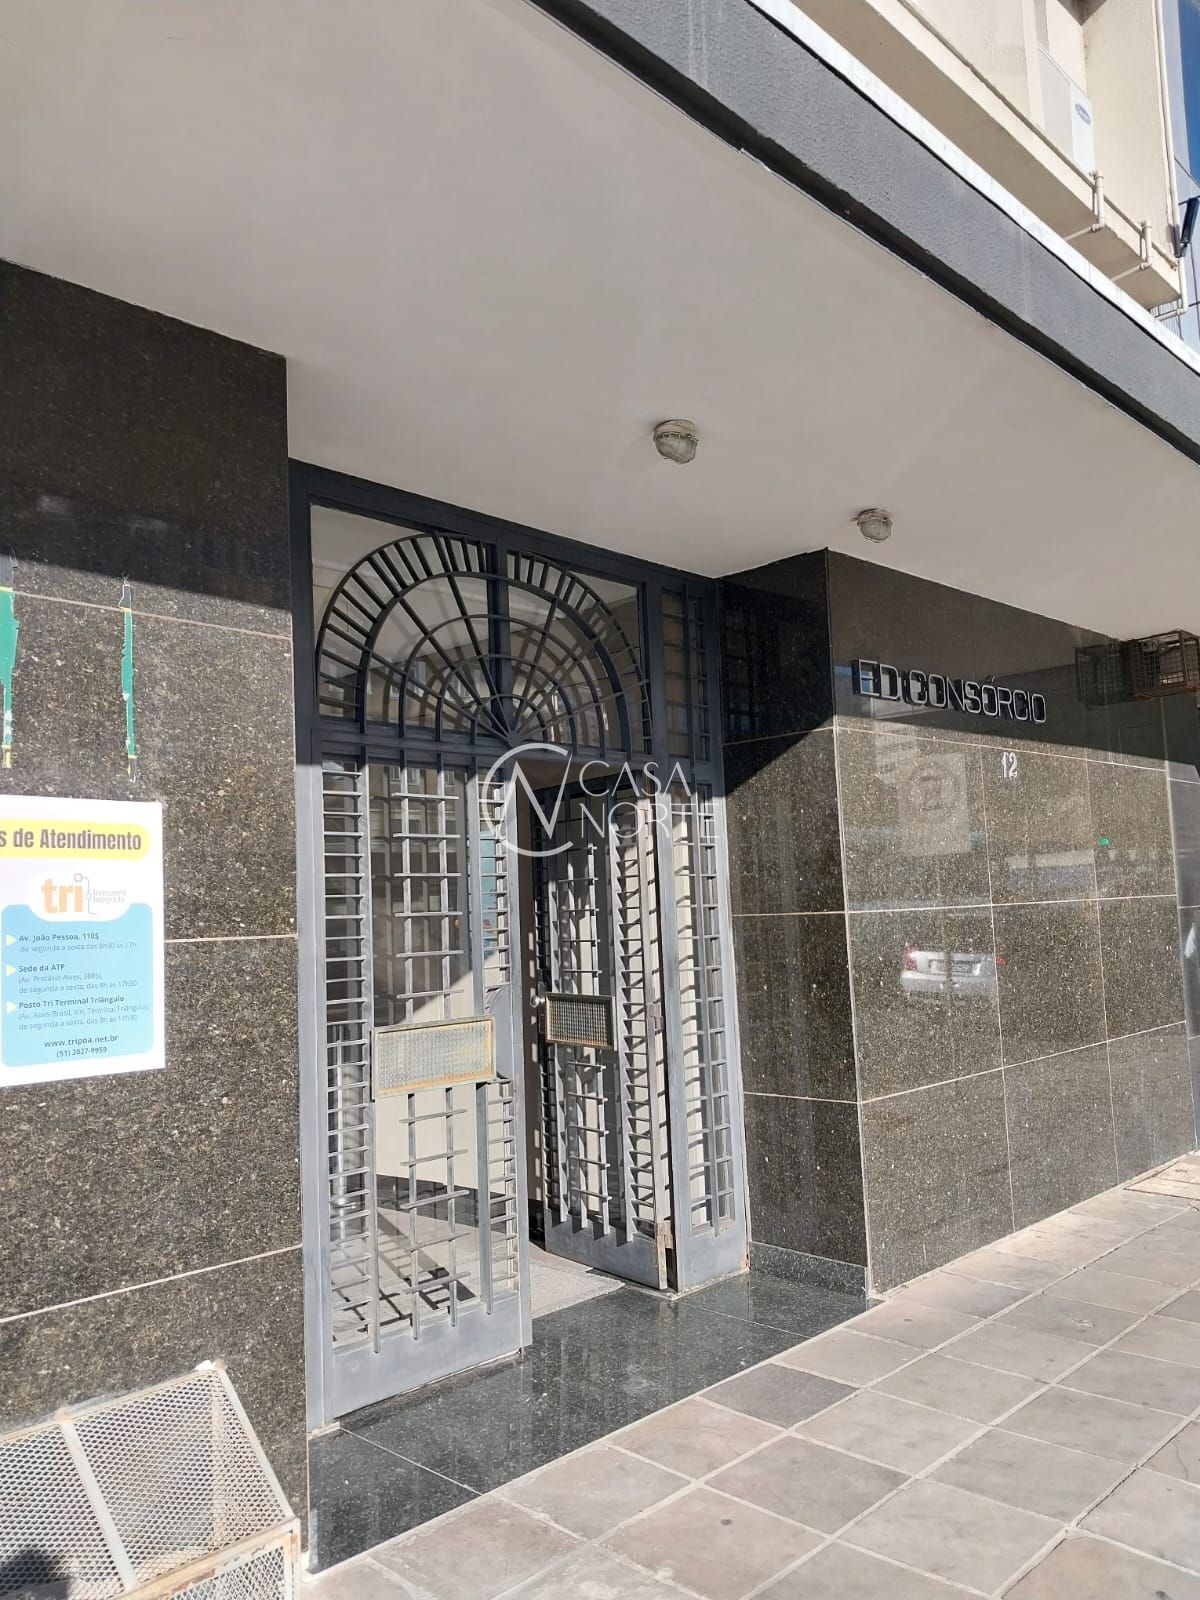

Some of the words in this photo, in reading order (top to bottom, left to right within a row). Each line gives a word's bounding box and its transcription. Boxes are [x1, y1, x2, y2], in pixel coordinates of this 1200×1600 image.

[906, 669, 1047, 724] CONSÓRCIO
[1001, 751, 1018, 779] 12
[13, 828, 34, 848] de
[39, 828, 142, 850] Atendimento
[41, 878, 83, 913] tri
[32, 933, 51, 943] João
[82, 932, 100, 940] 1105
[18, 964, 38, 973] Sede
[18, 1001, 41, 1009] Posto
[55, 997, 88, 1007] Terminal
[90, 995, 125, 1005] Triângulo
[43, 1034, 119, 1048] www.tripoa.net.br
